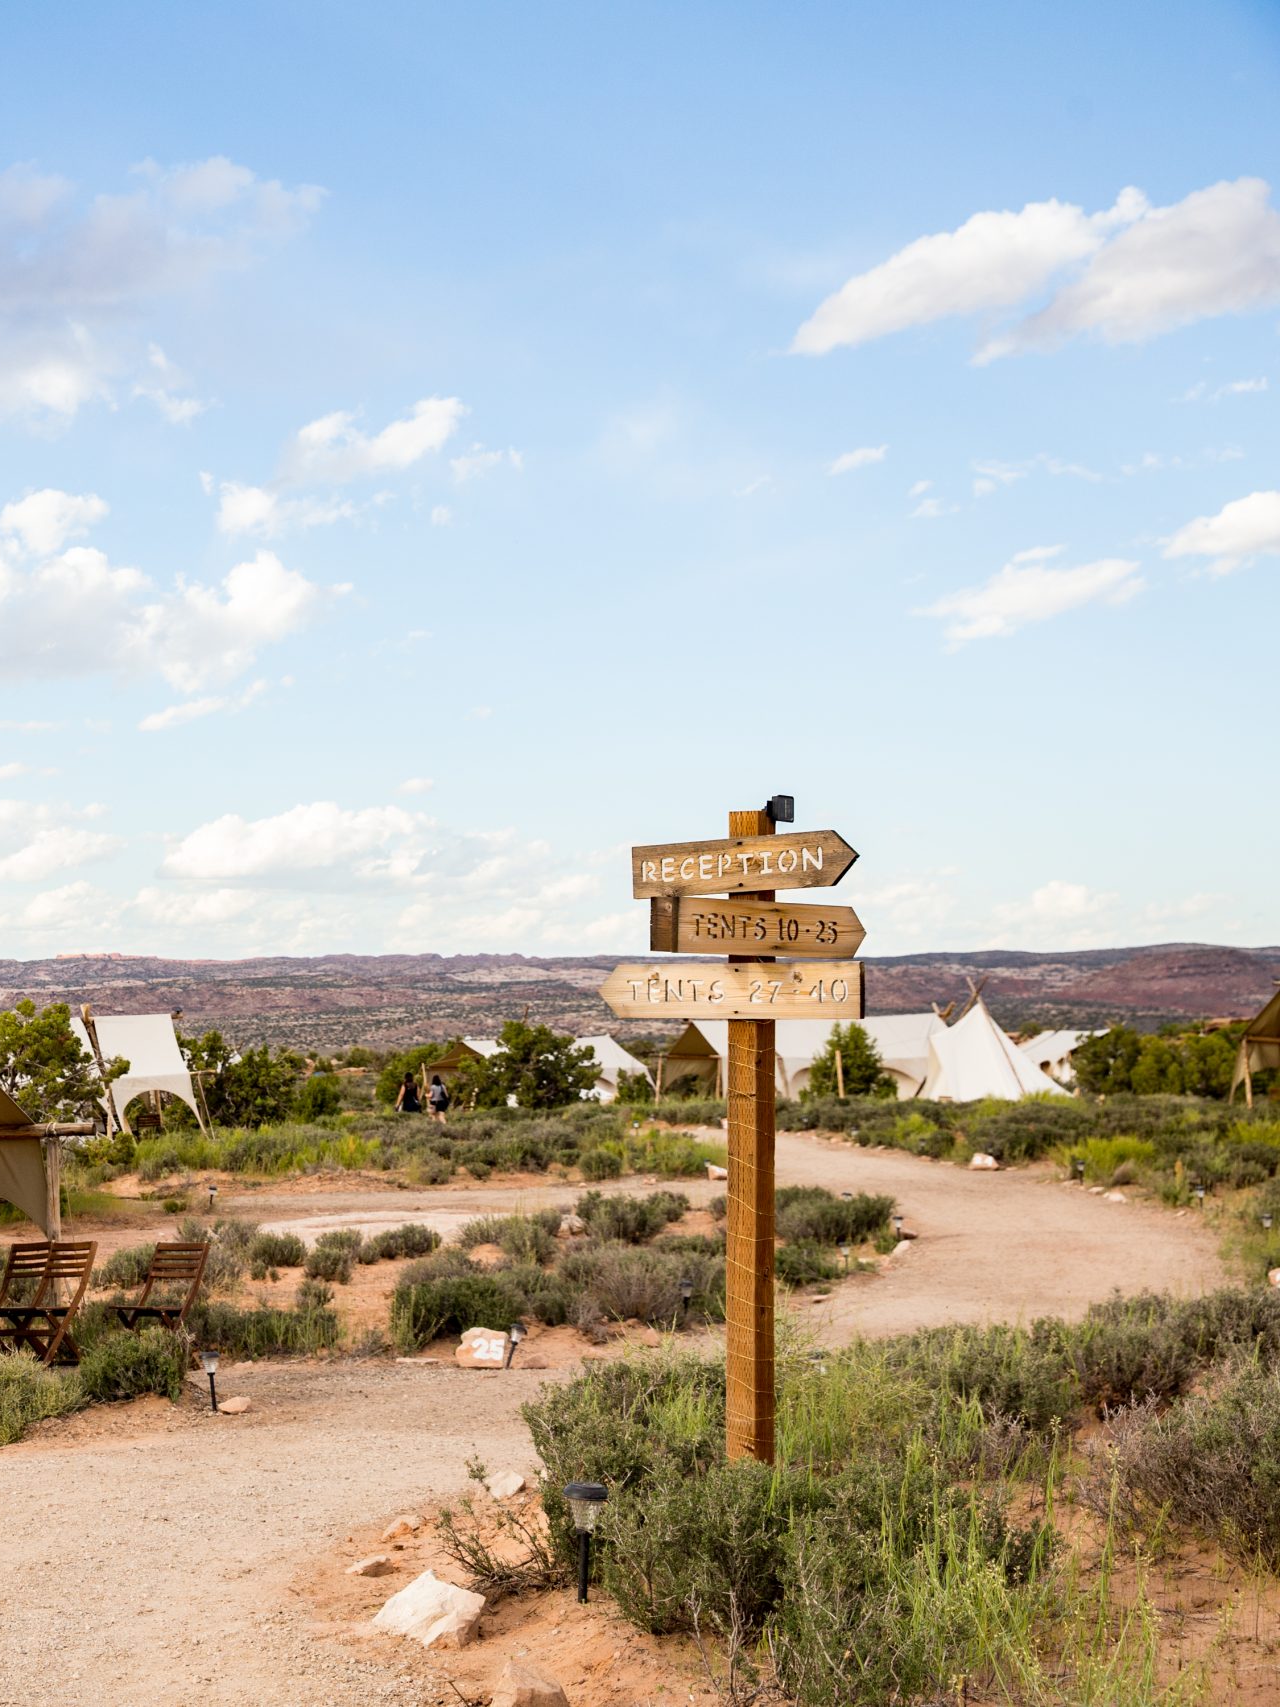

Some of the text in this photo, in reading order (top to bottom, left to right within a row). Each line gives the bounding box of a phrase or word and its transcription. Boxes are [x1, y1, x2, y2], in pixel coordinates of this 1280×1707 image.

[641, 846, 824, 883] RECEPTION
[691, 912, 767, 941] TENTS
[626, 978, 726, 1004] TENTS
[471, 1337, 505, 1361] 25
